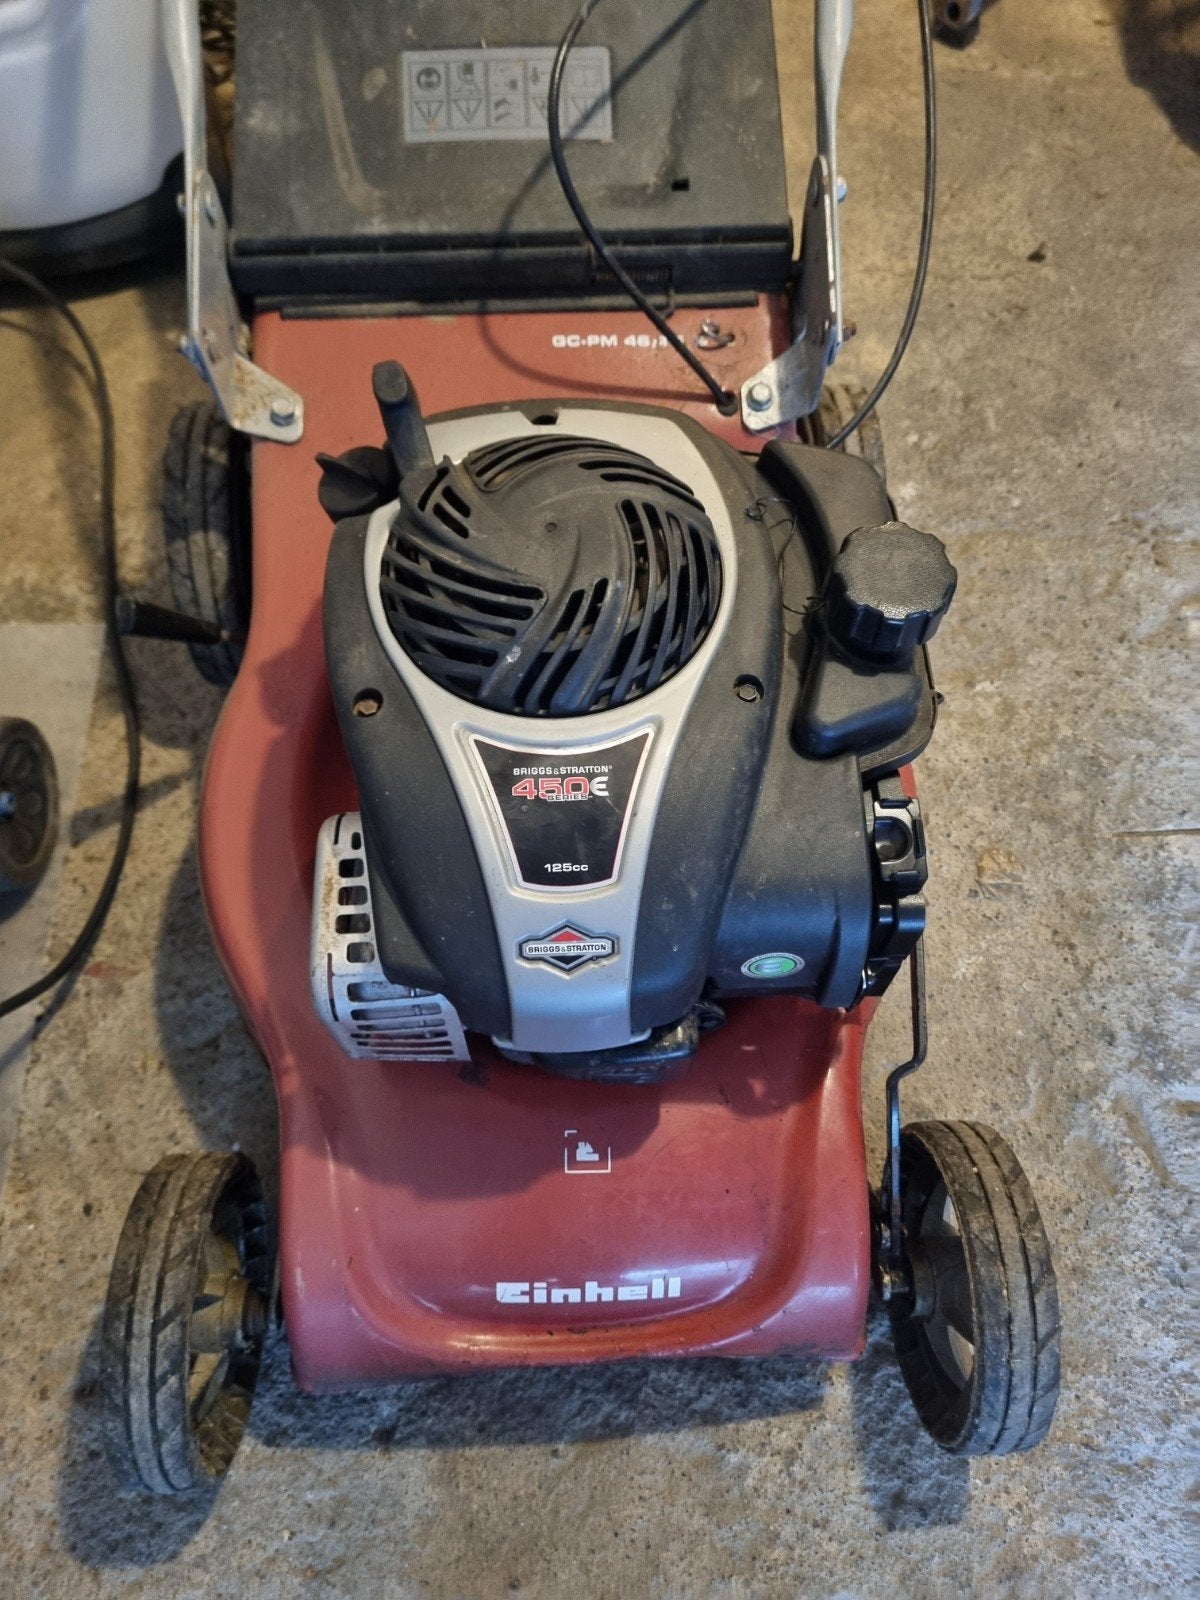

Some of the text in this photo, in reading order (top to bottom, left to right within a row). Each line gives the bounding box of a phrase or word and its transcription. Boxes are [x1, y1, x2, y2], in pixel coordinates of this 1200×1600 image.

[552, 334, 618, 348] GC-PM
[546, 792, 590, 802] SERIES
[544, 863, 589, 873] 125cc
[496, 1276, 682, 1304] Einhell
